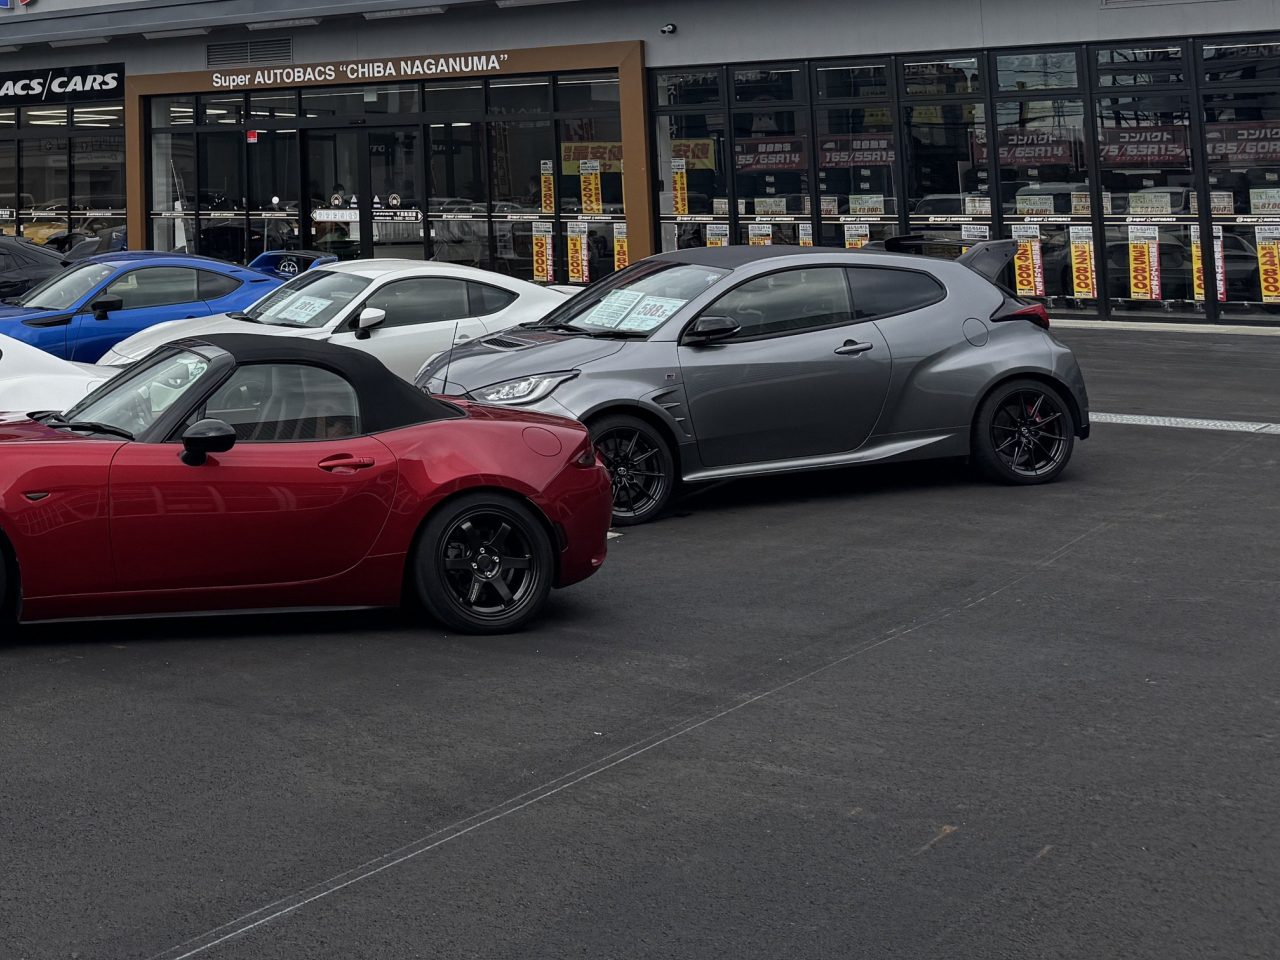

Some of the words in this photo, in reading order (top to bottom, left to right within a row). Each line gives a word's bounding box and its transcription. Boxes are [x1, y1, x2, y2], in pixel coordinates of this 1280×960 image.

[212, 73, 251, 89] Super
[254, 65, 335, 85] AUTOBACS
[1008, 135, 1057, 144] コンパクト
[1120, 132, 1172, 142] コンパクト
[982, 146, 1064, 158] 15/65R14
[1097, 144, 1180, 156] 75/65R15
[825, 151, 896, 162] 165/55R15
